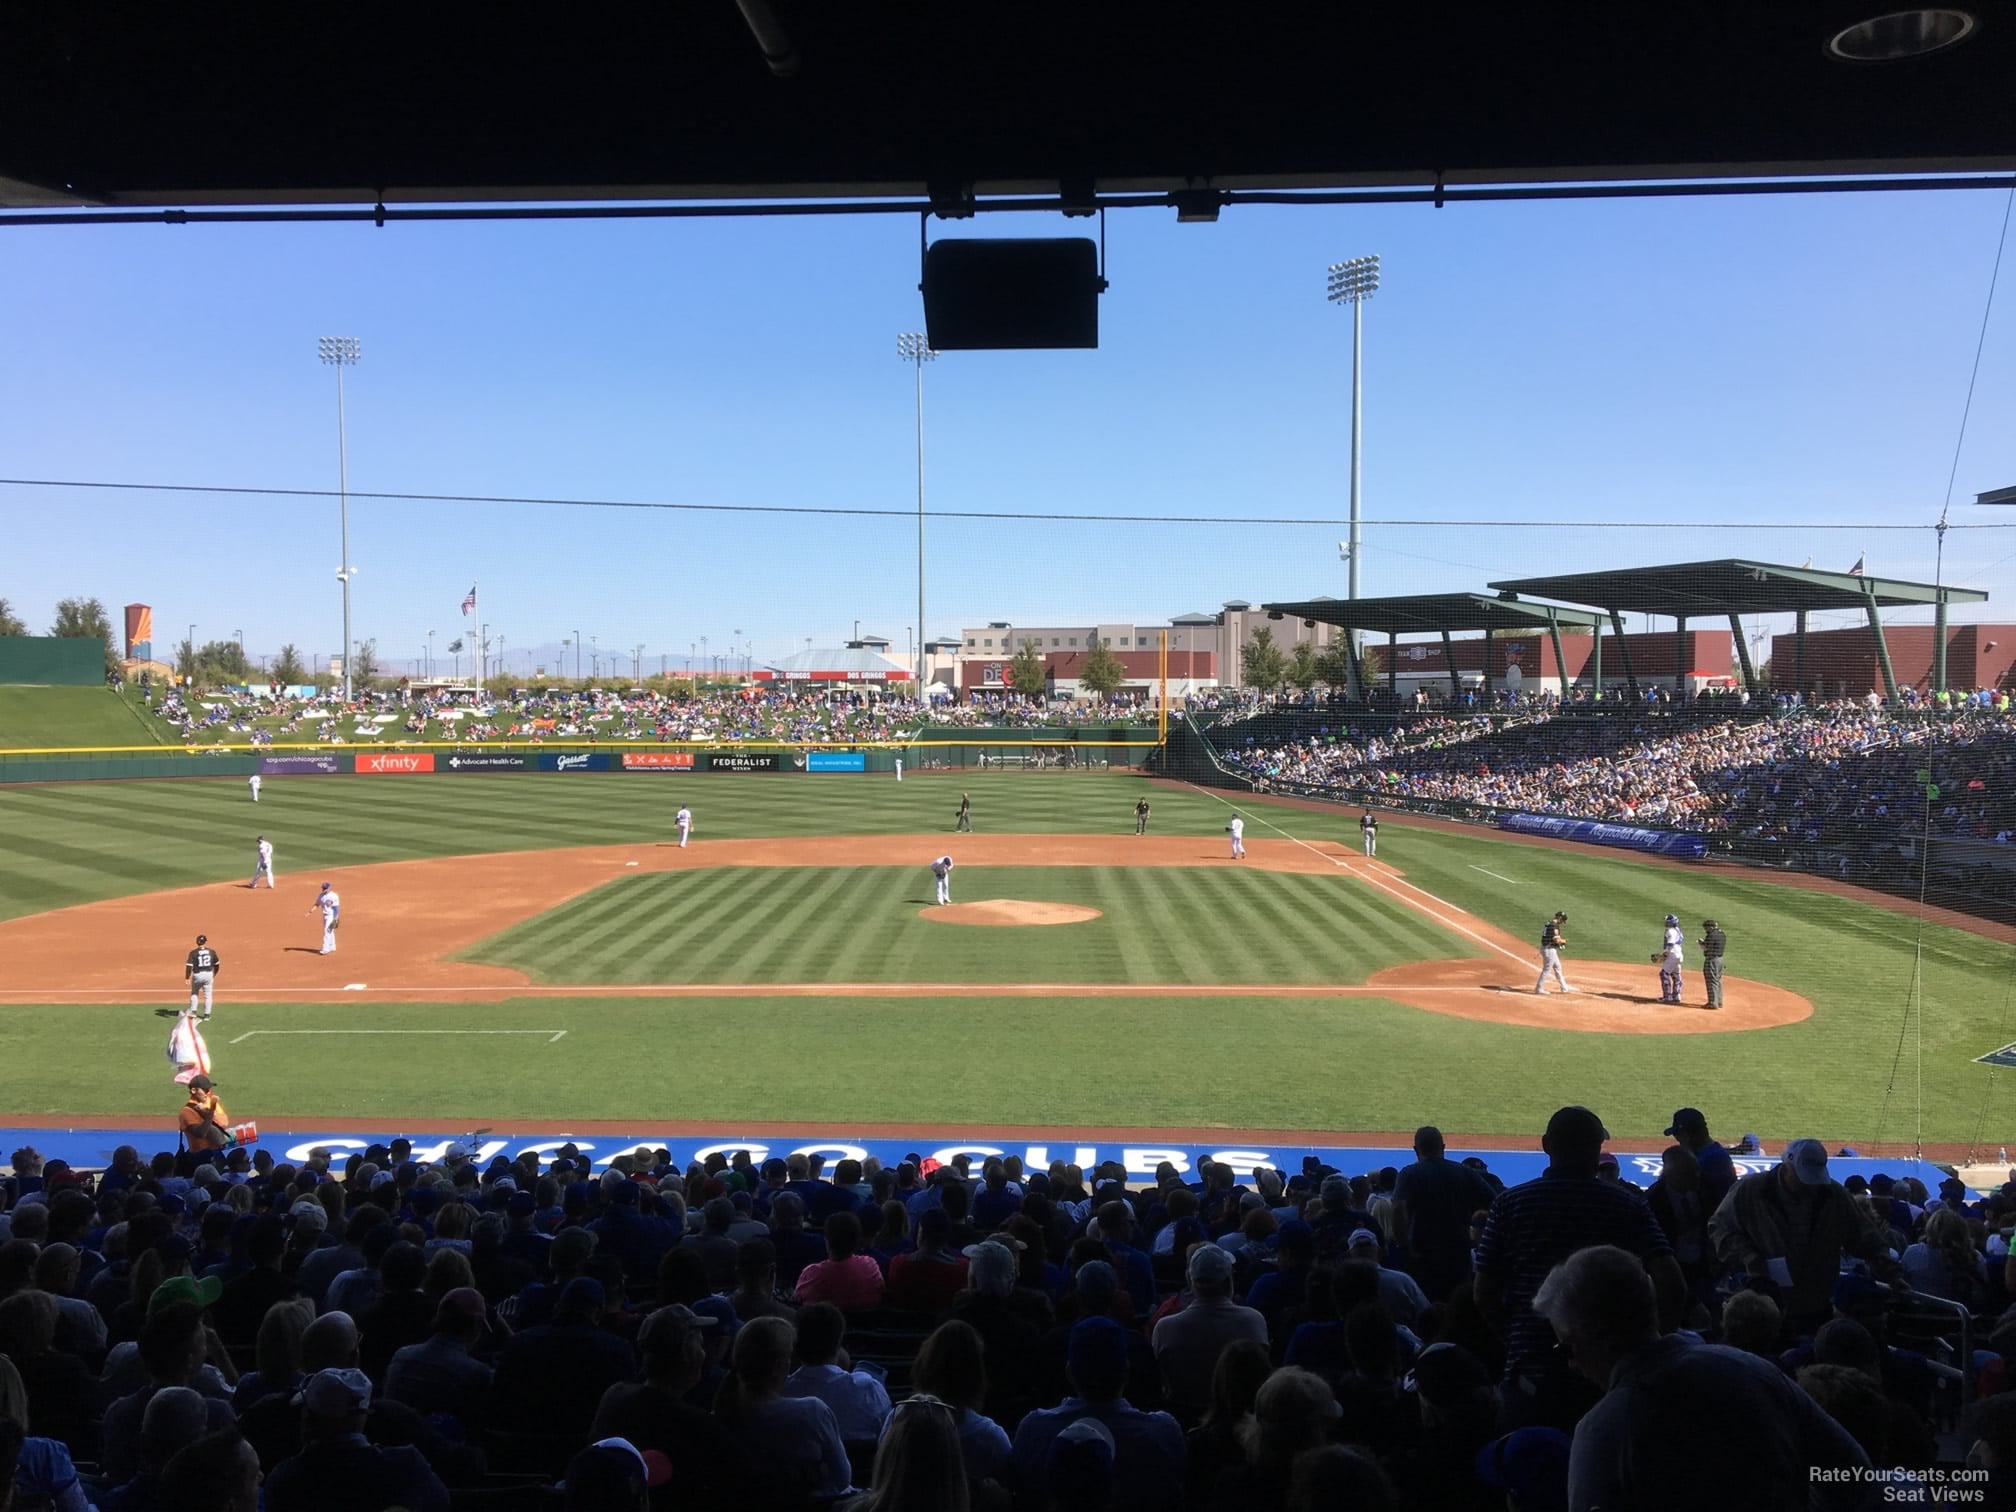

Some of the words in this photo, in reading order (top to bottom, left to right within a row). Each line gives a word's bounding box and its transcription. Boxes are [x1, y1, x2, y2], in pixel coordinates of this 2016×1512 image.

[984, 668, 1015, 685] DEC
[371, 755, 419, 772] xfinity
[1541, 819, 1565, 833] Wrap
[1590, 824, 1634, 839] Reynolds
[1631, 830, 1659, 846] Wrap
[198, 955, 211, 966] 12
[930, 1147, 1276, 1177] CUBS
